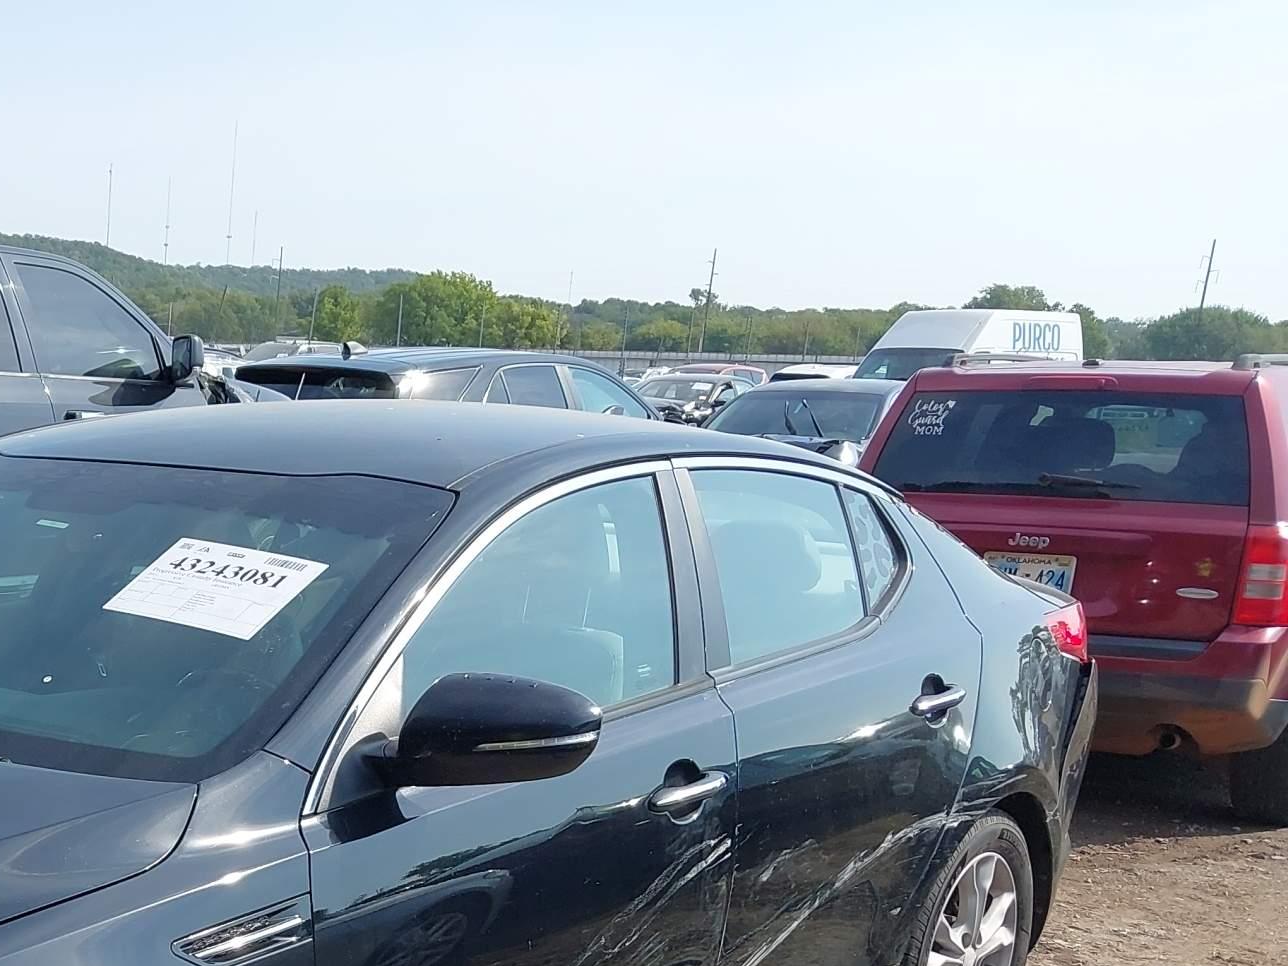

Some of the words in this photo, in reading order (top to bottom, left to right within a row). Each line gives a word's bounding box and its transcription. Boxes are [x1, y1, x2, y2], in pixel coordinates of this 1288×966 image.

[1013, 322, 1061, 352] PURCO
[908, 410, 949, 428] Guard
[914, 426, 944, 435] MOM
[1008, 532, 1050, 549] Jeep
[1006, 556, 1052, 565] OKLAHOMA
[169, 556, 288, 588] 43243081
